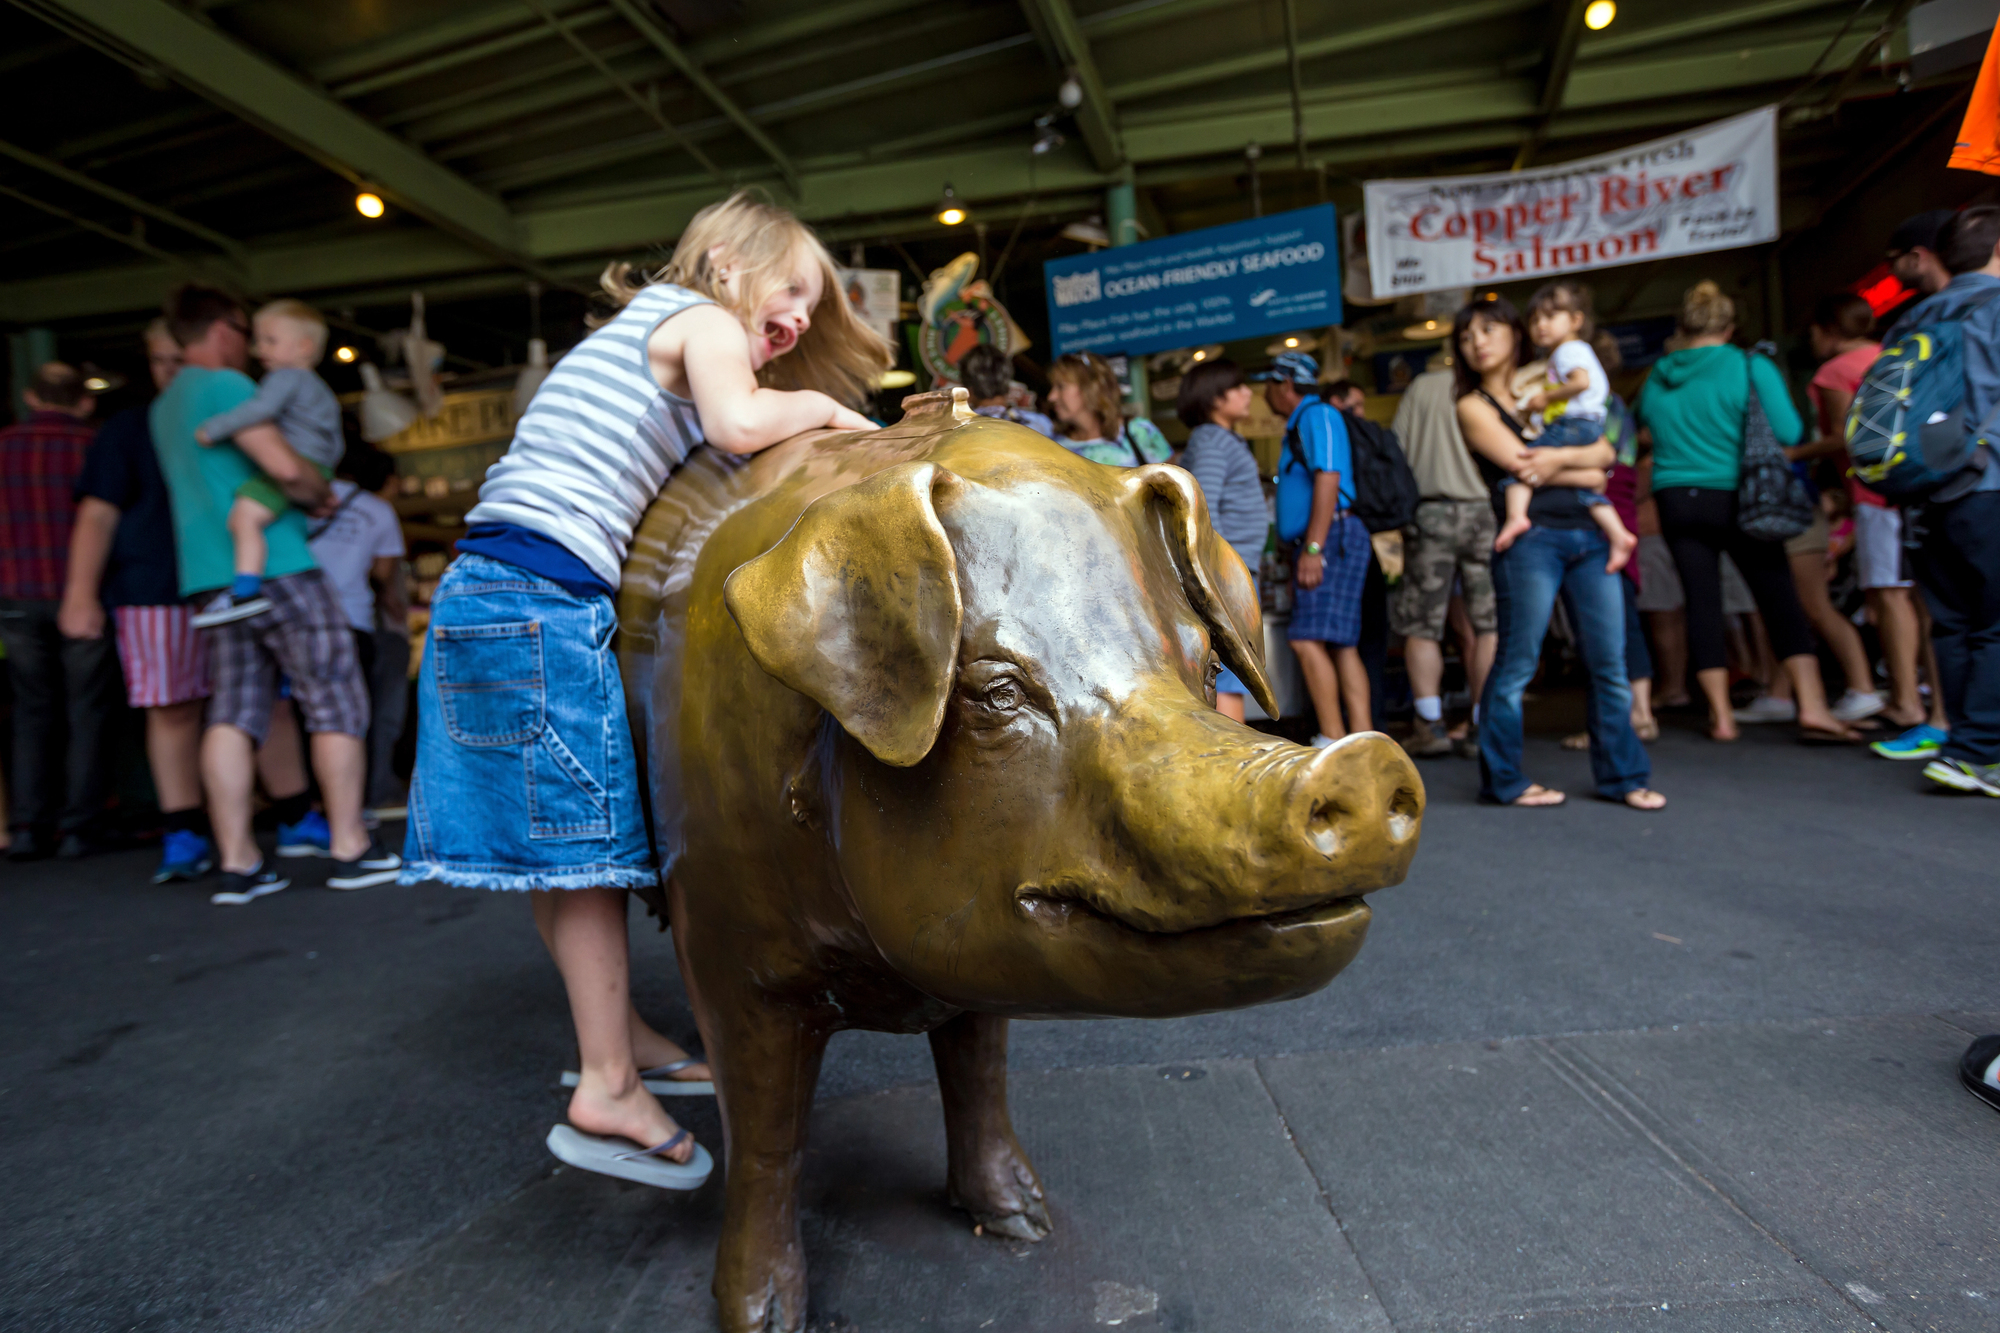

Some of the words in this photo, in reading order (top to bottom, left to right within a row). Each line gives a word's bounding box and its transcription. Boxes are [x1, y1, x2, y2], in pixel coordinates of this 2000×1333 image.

[1409, 192, 1582, 245] Copper
[1598, 161, 1739, 216] River
[1240, 242, 1325, 274] SEAFOOD
[1471, 225, 1660, 280] Salmon
